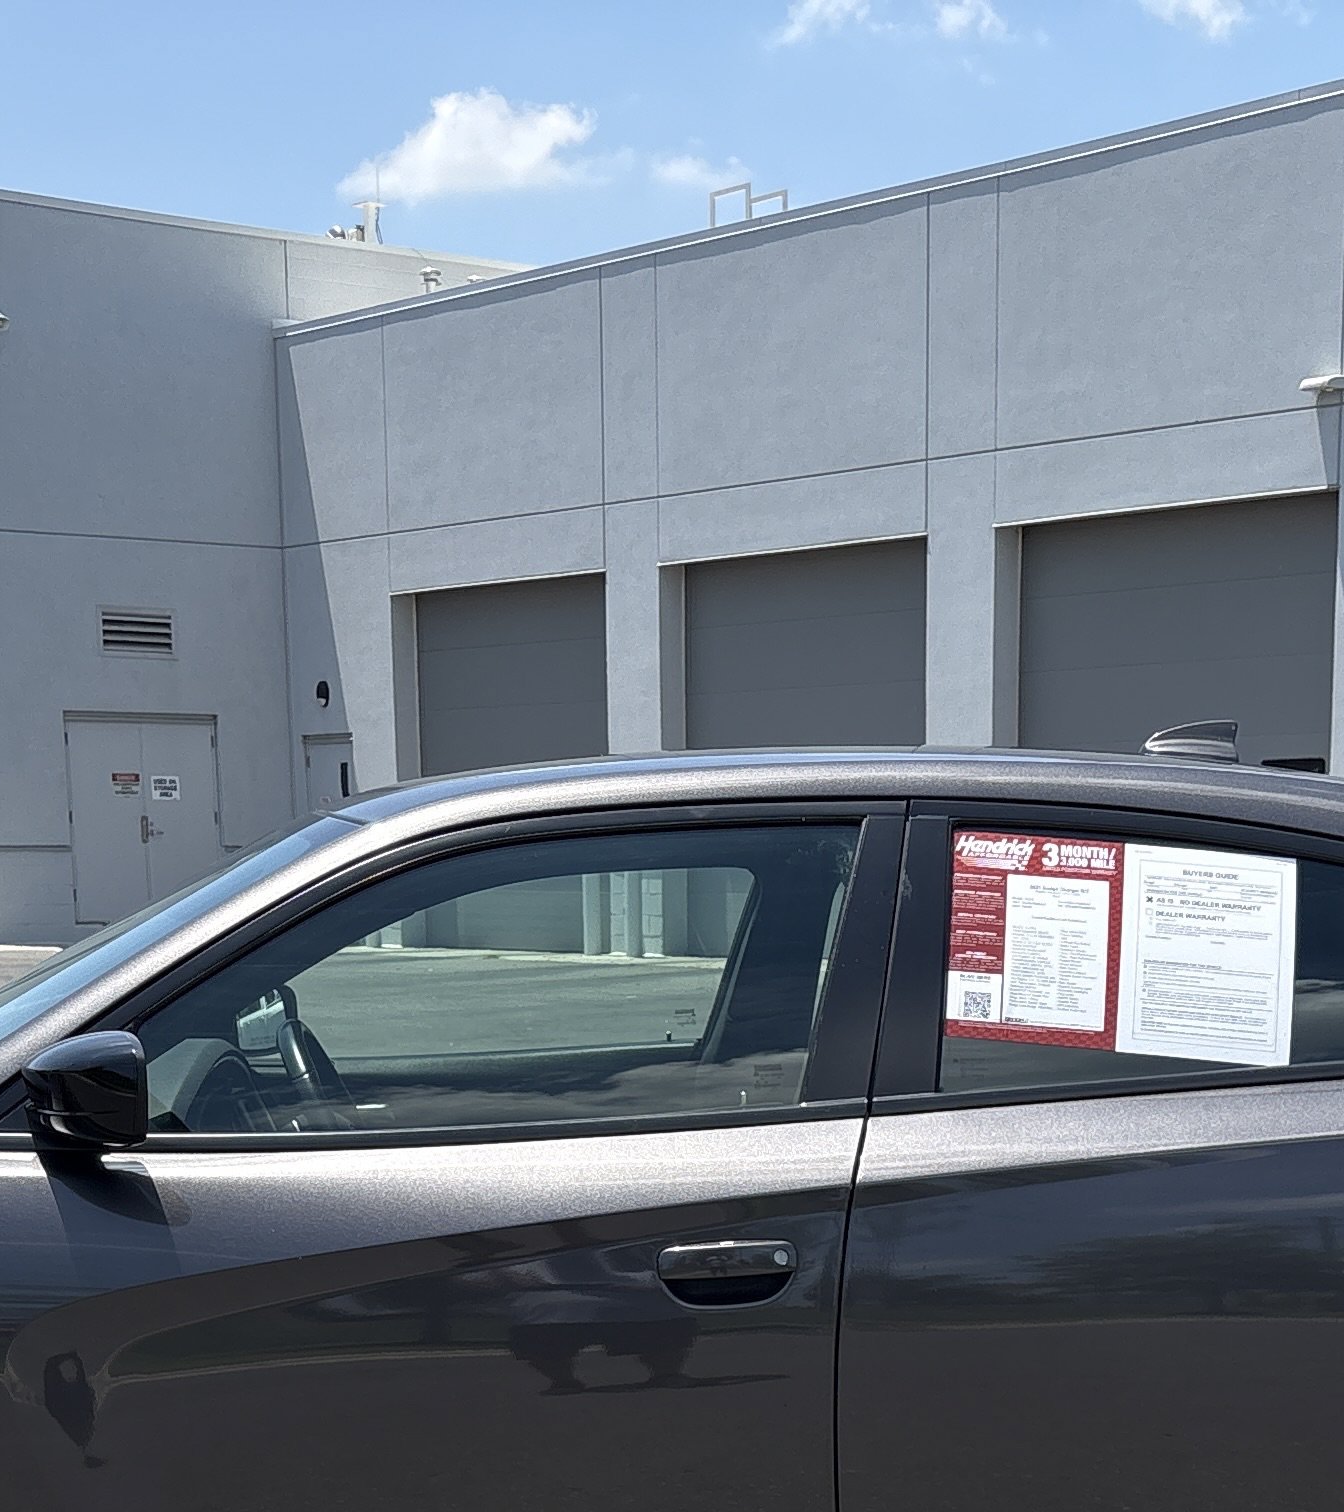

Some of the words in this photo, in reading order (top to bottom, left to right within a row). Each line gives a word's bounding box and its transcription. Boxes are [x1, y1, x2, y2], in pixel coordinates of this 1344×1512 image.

[955, 835, 1036, 860] Hendrick
[1041, 842, 1059, 867] 3
[1060, 844, 1116, 860] MONTH/
[1059, 857, 1089, 867] 3,000
[1090, 859, 1116, 869] MILE
[1192, 900, 1219, 908] DEALER
[1221, 903, 1262, 911] WARRANTY
[1186, 913, 1226, 922] WARRANTY
